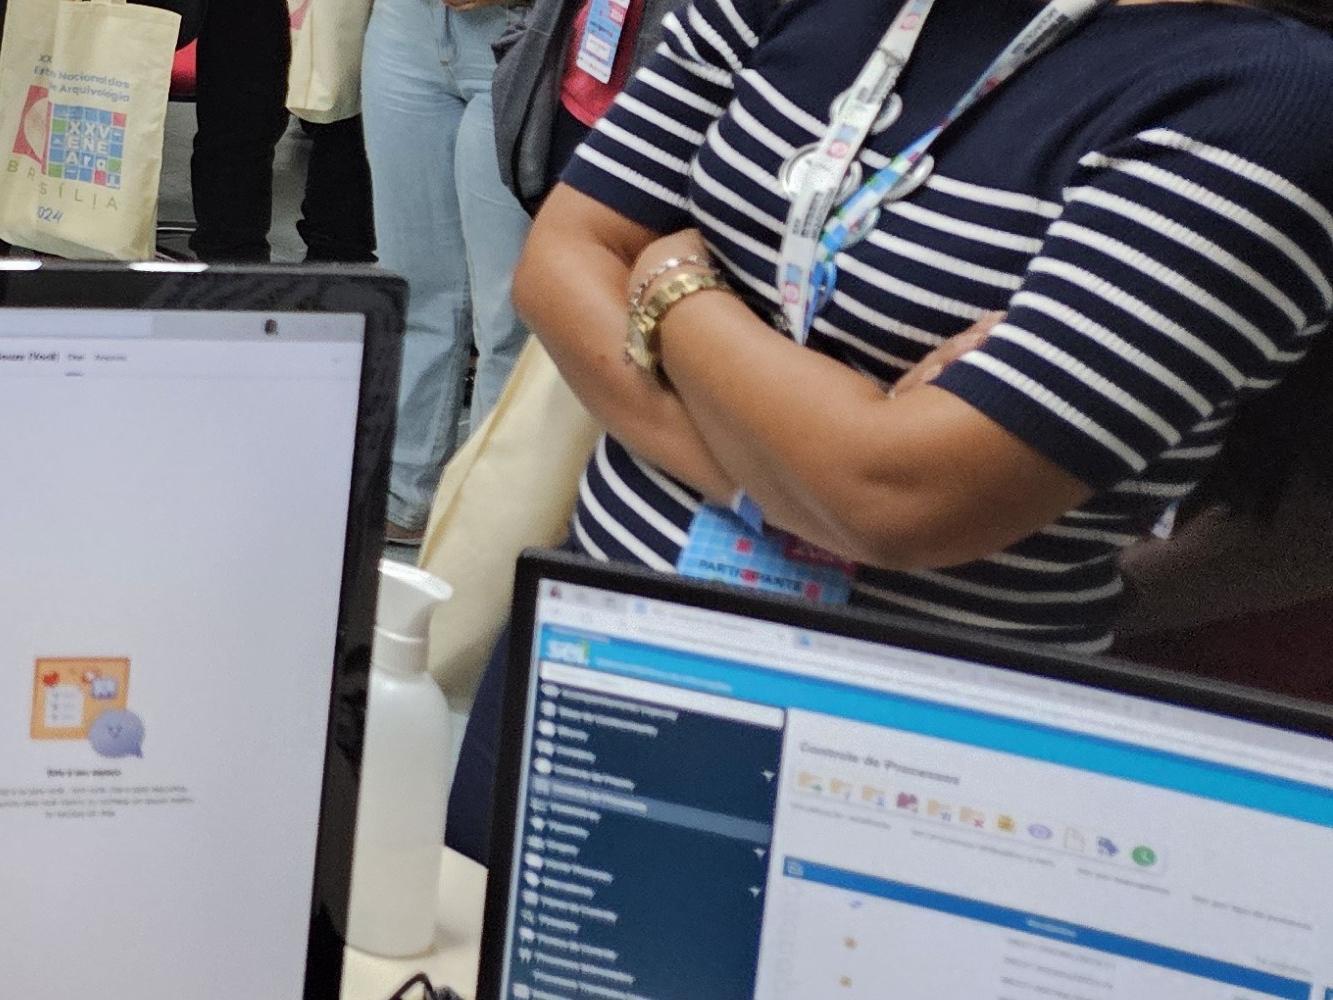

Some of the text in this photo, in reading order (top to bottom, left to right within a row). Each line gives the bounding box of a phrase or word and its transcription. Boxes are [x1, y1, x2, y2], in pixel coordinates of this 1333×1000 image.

[59, 84, 130, 102] Arquivologia
[68, 119, 111, 138] XXV
[66, 136, 110, 155] ENE
[6, 159, 119, 211] BRSÍLIA
[37, 205, 65, 223] 024
